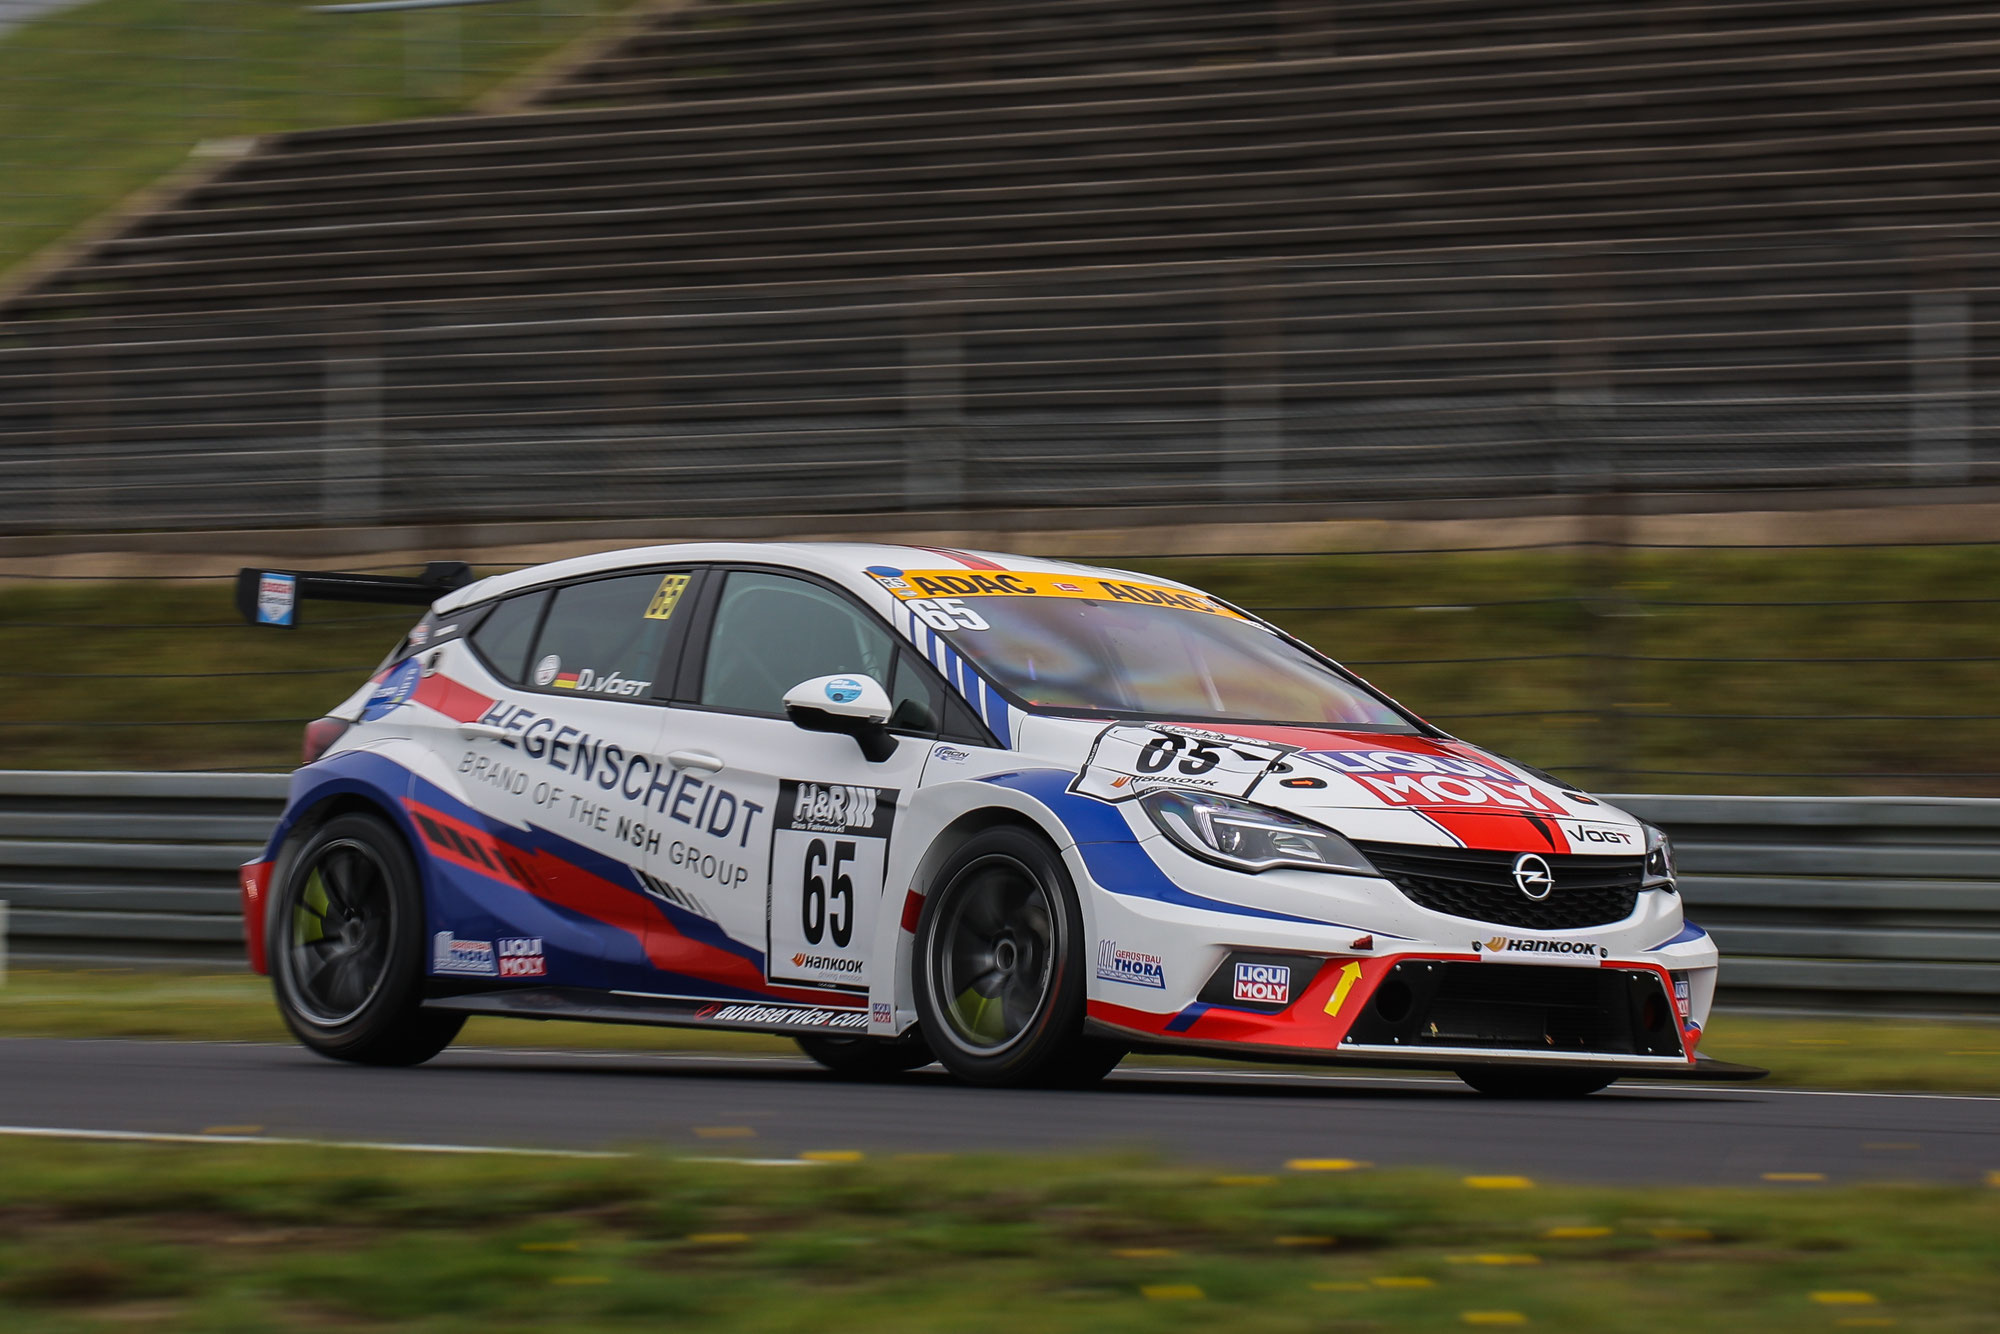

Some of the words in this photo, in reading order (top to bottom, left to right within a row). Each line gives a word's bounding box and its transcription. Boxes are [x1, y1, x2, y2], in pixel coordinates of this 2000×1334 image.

[911, 575, 1037, 595] ADAC
[1099, 581, 1217, 613] ADAC
[904, 598, 990, 631] 65
[575, 669, 652, 696] D.VOGT
[480, 700, 764, 848] HEGENSCHEIDT
[1308, 752, 1519, 782] LIQUI
[793, 783, 848, 825] H&R
[1358, 775, 1551, 811] MOLY
[458, 751, 529, 797] BRAND
[532, 781, 564, 810] OF
[569, 795, 610, 832] THE
[615, 815, 661, 855] NSH
[669, 841, 749, 889] GROUP
[1566, 825, 1632, 845] VOGT
[802, 838, 857, 948] 65
[1115, 950, 1162, 964] GERÜSTBAU
[1506, 939, 1598, 955] Hankook
[499, 956, 546, 976] MOLY
[804, 955, 864, 973] Hankook
[1115, 958, 1163, 977] THORA
[1238, 966, 1286, 984] LIQUI
[1237, 982, 1286, 1000] MOLY
